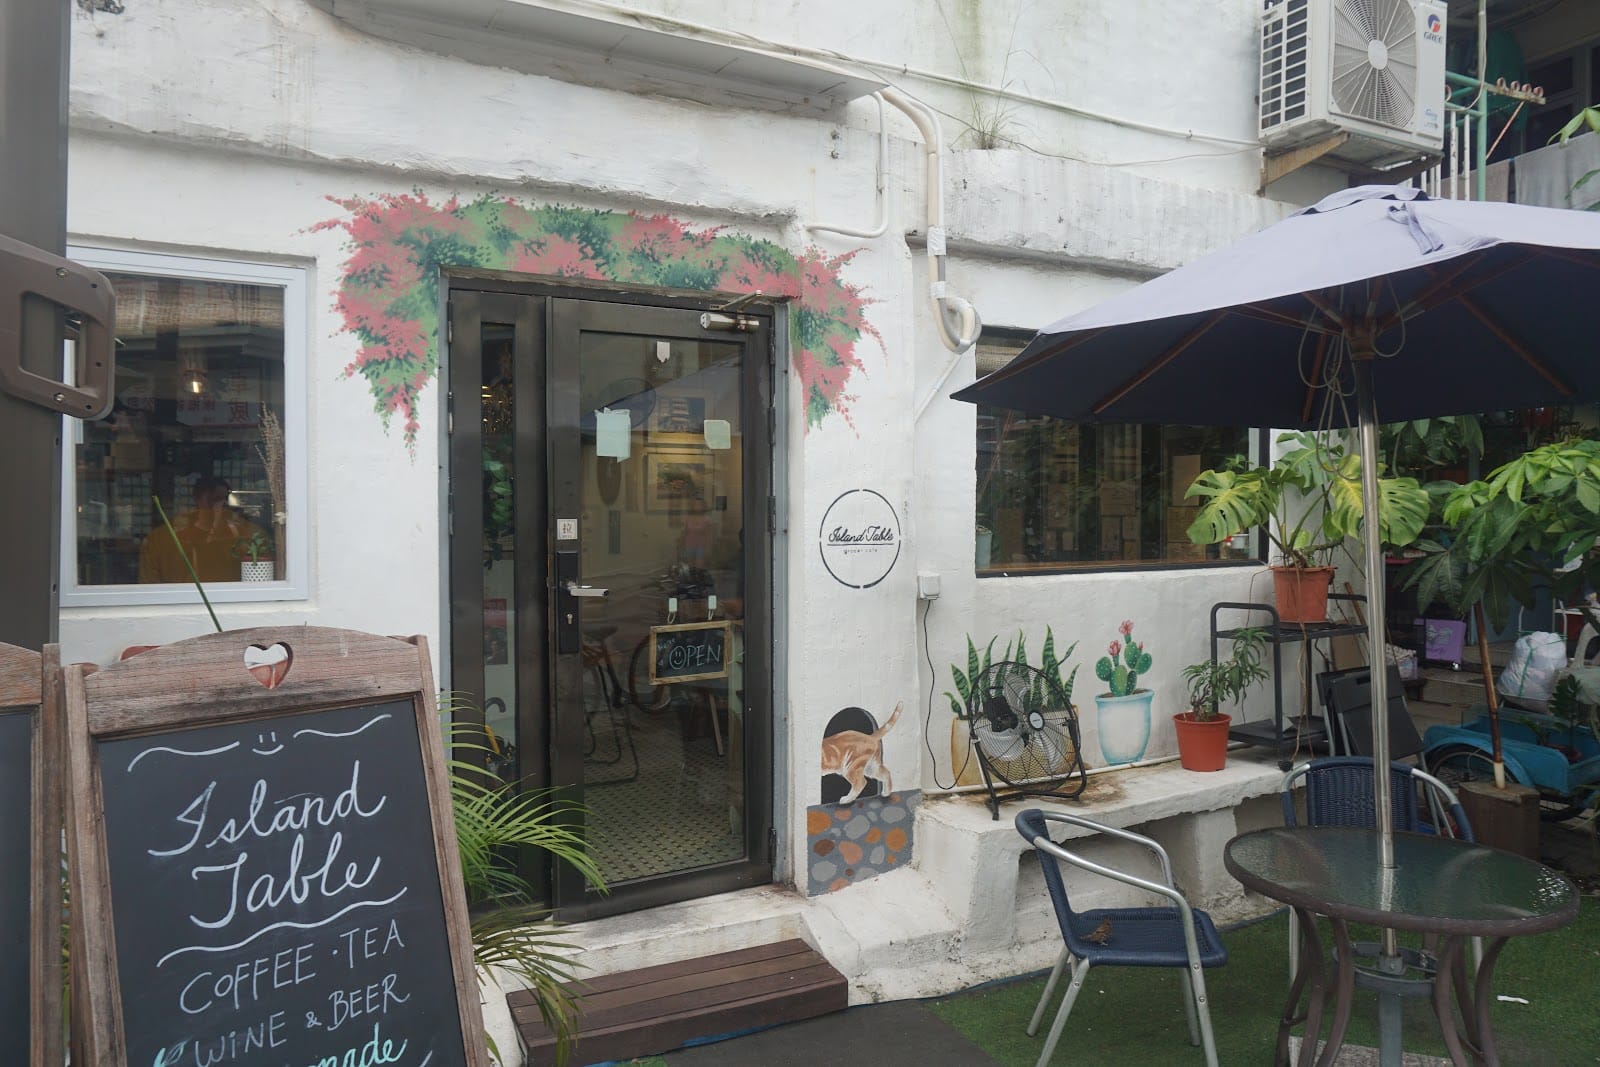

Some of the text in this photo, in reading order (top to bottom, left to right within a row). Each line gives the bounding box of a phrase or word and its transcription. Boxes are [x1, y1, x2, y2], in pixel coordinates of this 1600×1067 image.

[828, 525, 894, 543] Island Table
[669, 644, 721, 670] OPEN
[147, 759, 387, 857] Island
[189, 831, 382, 929] Table
[339, 919, 406, 969] TEA
[305, 1011, 323, 1028] &
[327, 972, 411, 1031] BEER
